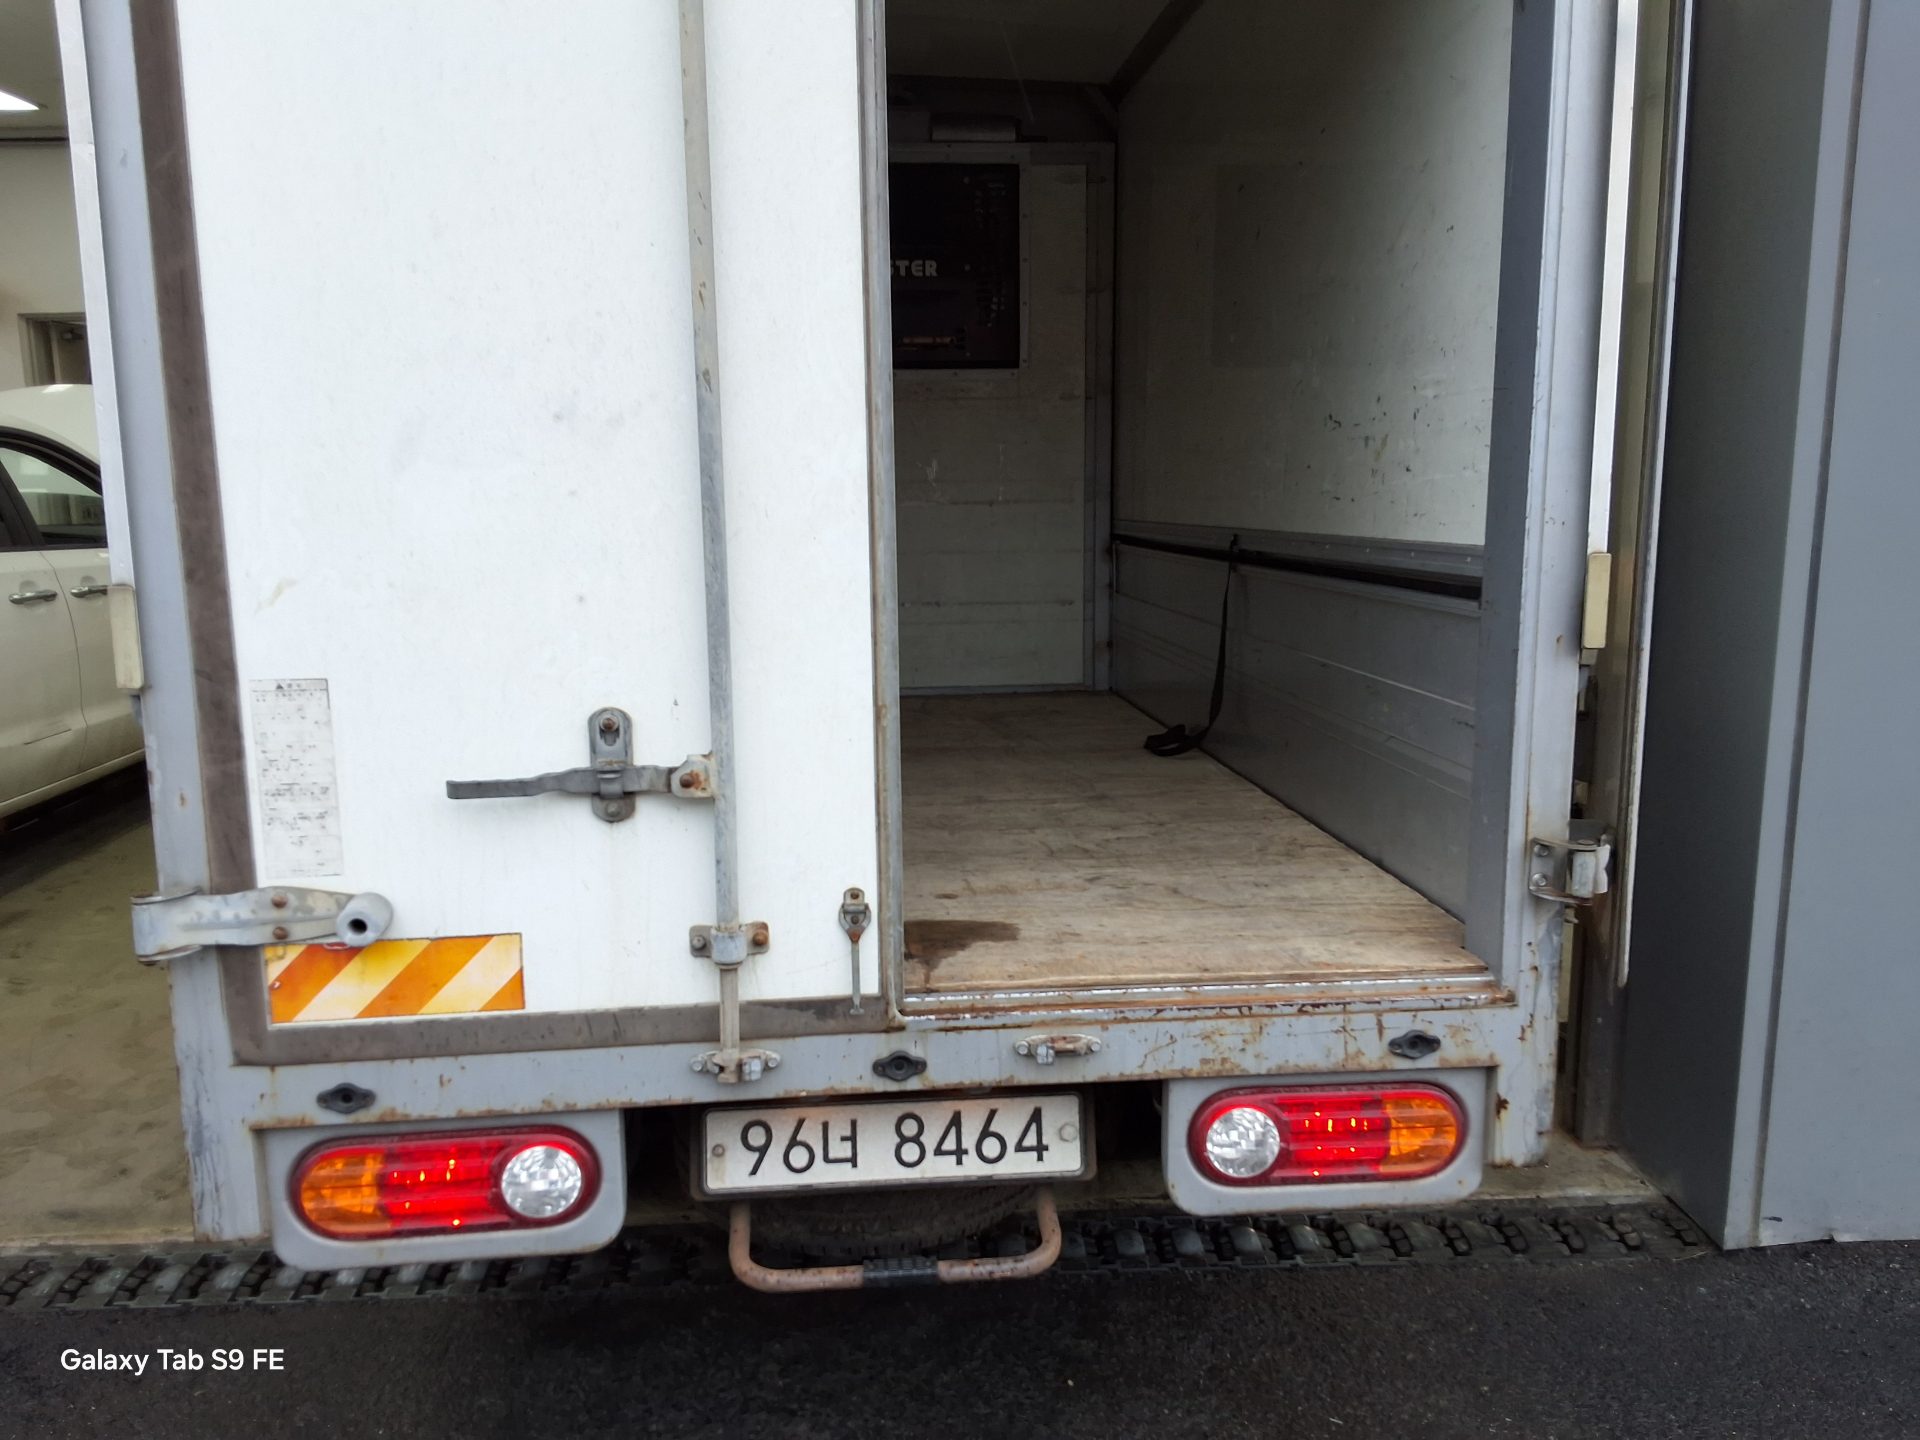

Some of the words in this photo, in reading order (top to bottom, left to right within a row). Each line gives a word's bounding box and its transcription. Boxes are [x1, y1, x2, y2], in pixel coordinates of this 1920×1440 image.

[891, 259, 938, 277] TER
[740, 1117, 858, 1176] 96너
[894, 1107, 1049, 1168] 8464
